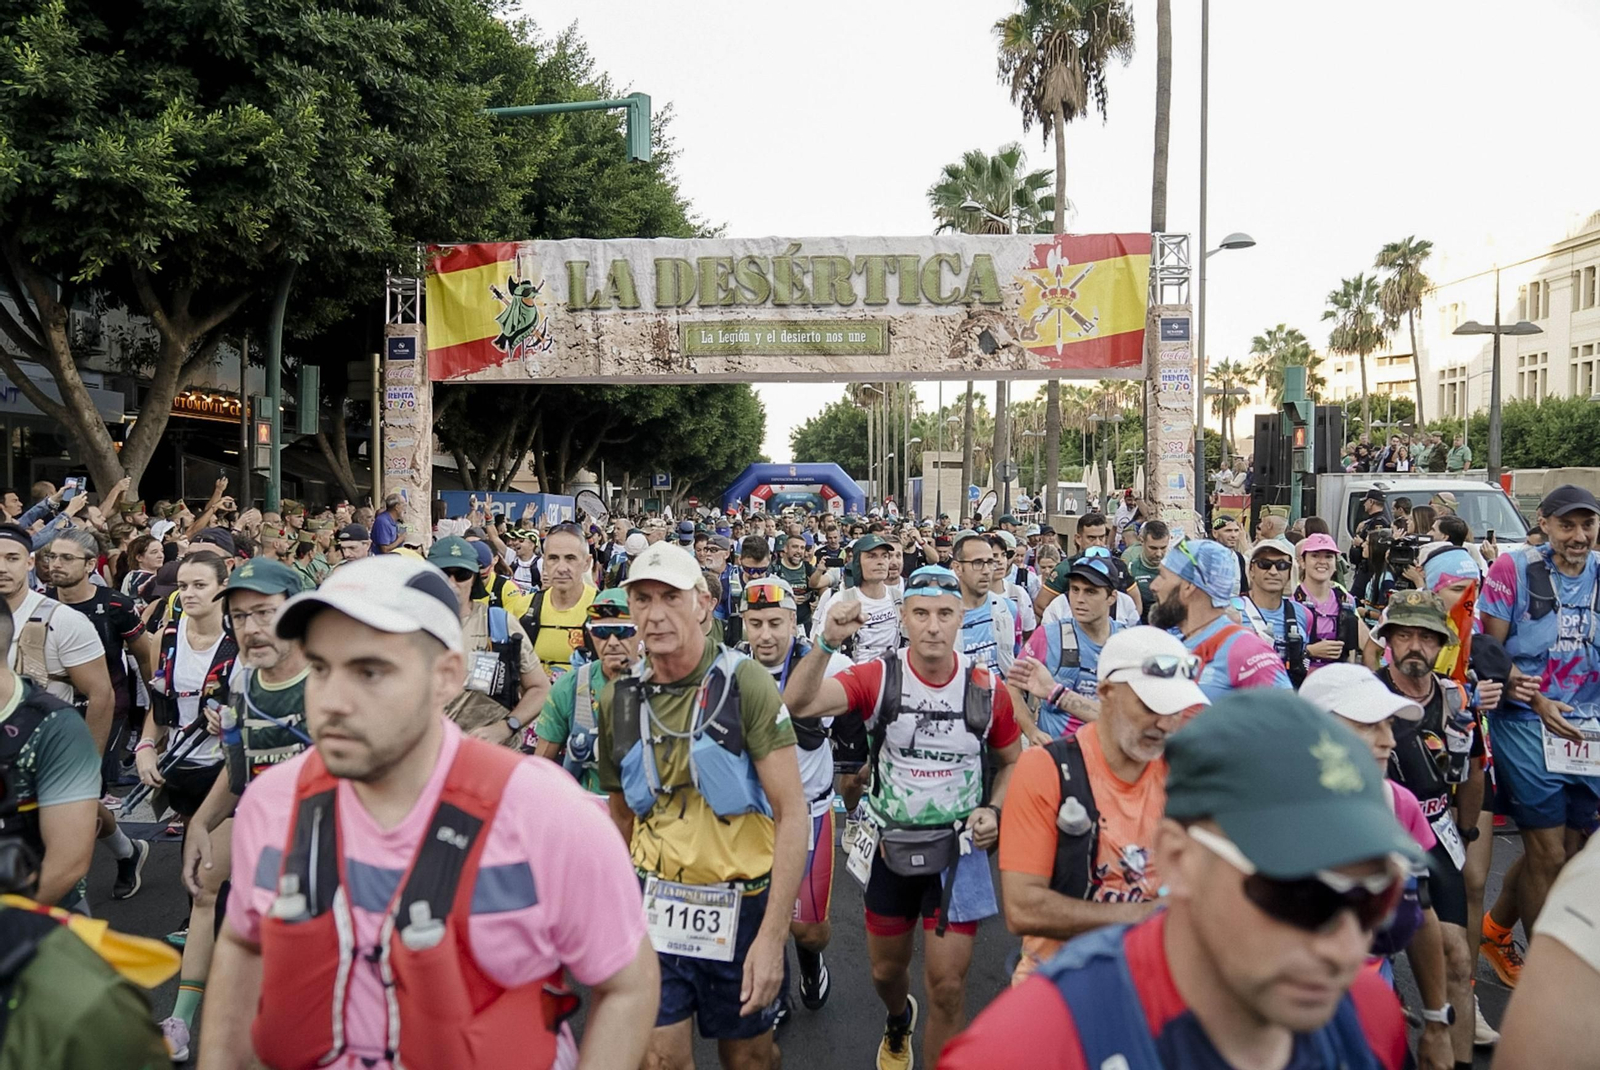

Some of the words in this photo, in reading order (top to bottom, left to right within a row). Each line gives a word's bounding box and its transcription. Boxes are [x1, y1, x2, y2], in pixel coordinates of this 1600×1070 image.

[565, 258, 641, 310] LA
[654, 243, 1004, 307] DESÉRTICA
[701, 330, 714, 343] La
[718, 329, 750, 345] Legión
[755, 333, 762, 345] y
[766, 329, 776, 343] el
[780, 330, 821, 343] desierto
[826, 332, 843, 343] nos
[848, 332, 866, 343] une
[1162, 374, 1190, 382] RENTA
[173, 395, 225, 414] UTOMOVIL
[656, 474, 667, 486] P
[1564, 741, 1589, 758] 171
[910, 769, 952, 778] VALTRA
[665, 904, 721, 934] 1163
[667, 942, 694, 952] asisa
